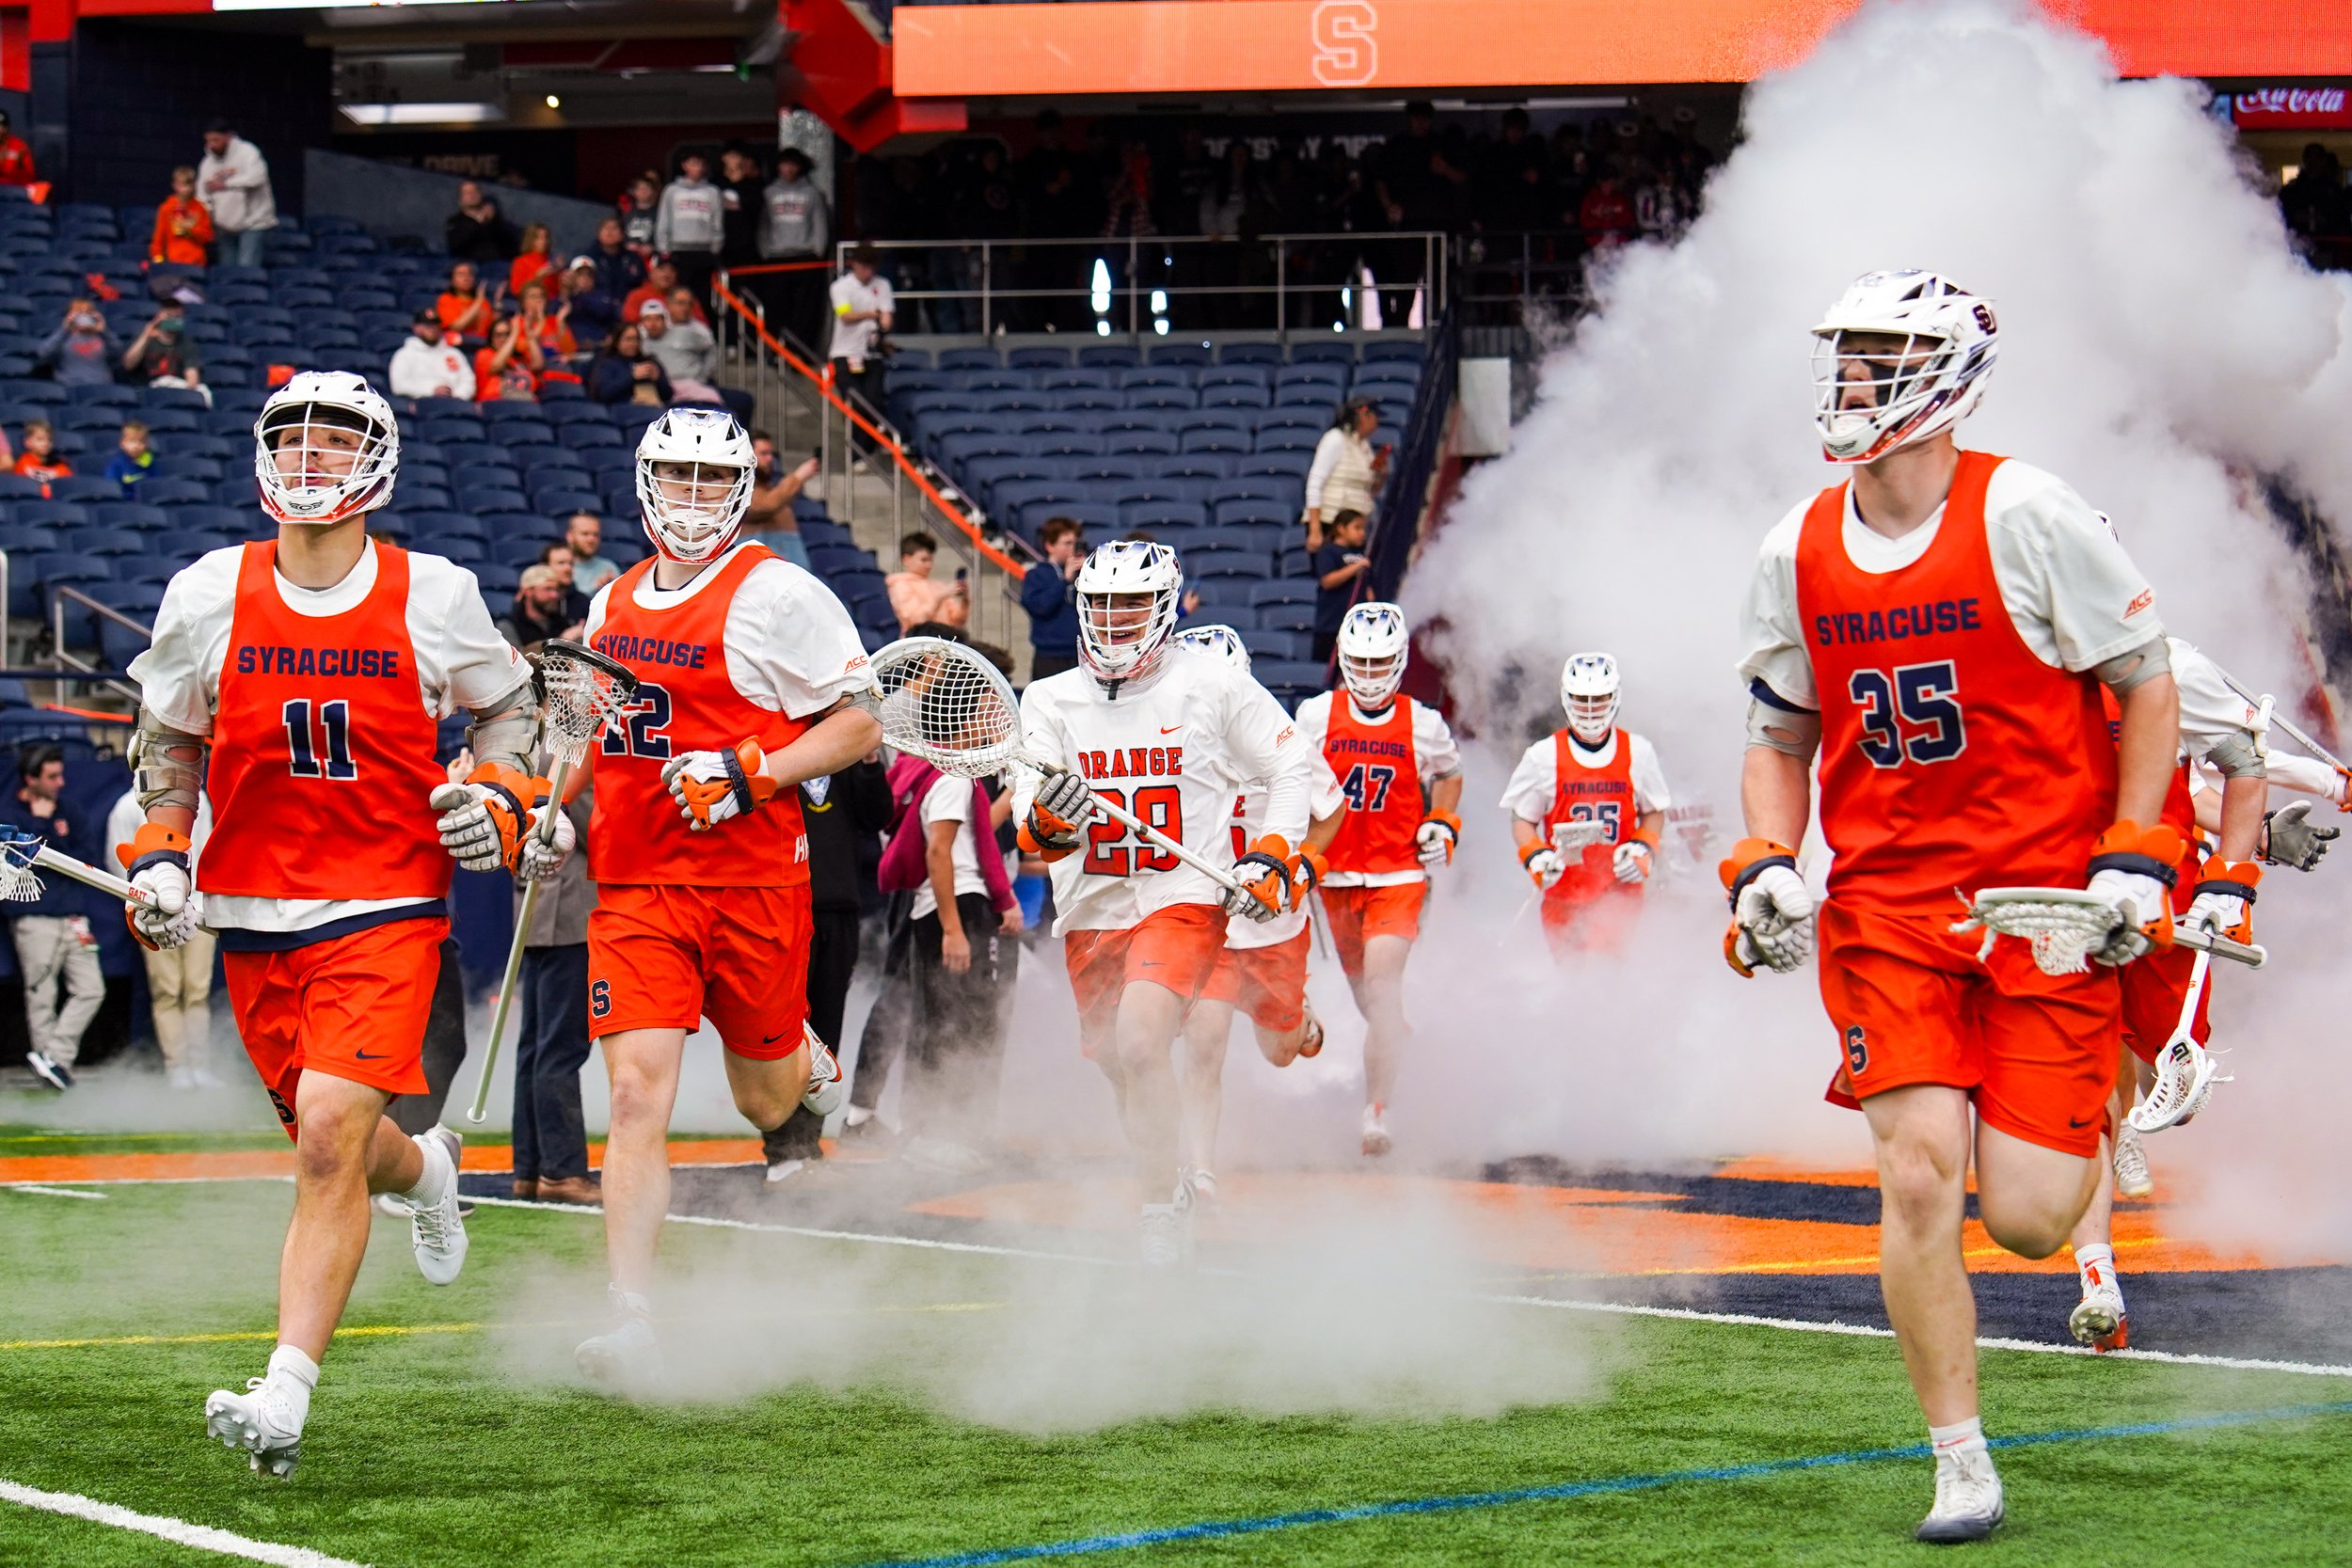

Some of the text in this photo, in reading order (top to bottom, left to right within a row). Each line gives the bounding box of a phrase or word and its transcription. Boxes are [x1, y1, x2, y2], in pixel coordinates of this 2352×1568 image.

[1312, 0, 1378, 87] S
[1816, 598, 1981, 646] SYRACUSE
[2123, 588, 2153, 618] ACC
[237, 645, 399, 678] SYRACUSE
[596, 634, 707, 670] SYRACUSE
[844, 655, 868, 674] ACC
[1848, 658, 1968, 769] 35
[282, 697, 358, 782] 11
[1276, 725, 1295, 748] ACC
[1330, 739, 1407, 758] SYRACUSE
[1077, 747, 1183, 780] ORANGE
[1343, 763, 1397, 813] 47
[1083, 784, 1184, 878] 29
[128, 886, 148, 902] GAIT
[591, 978, 612, 1019] S
[1846, 1024, 1870, 1076] S
